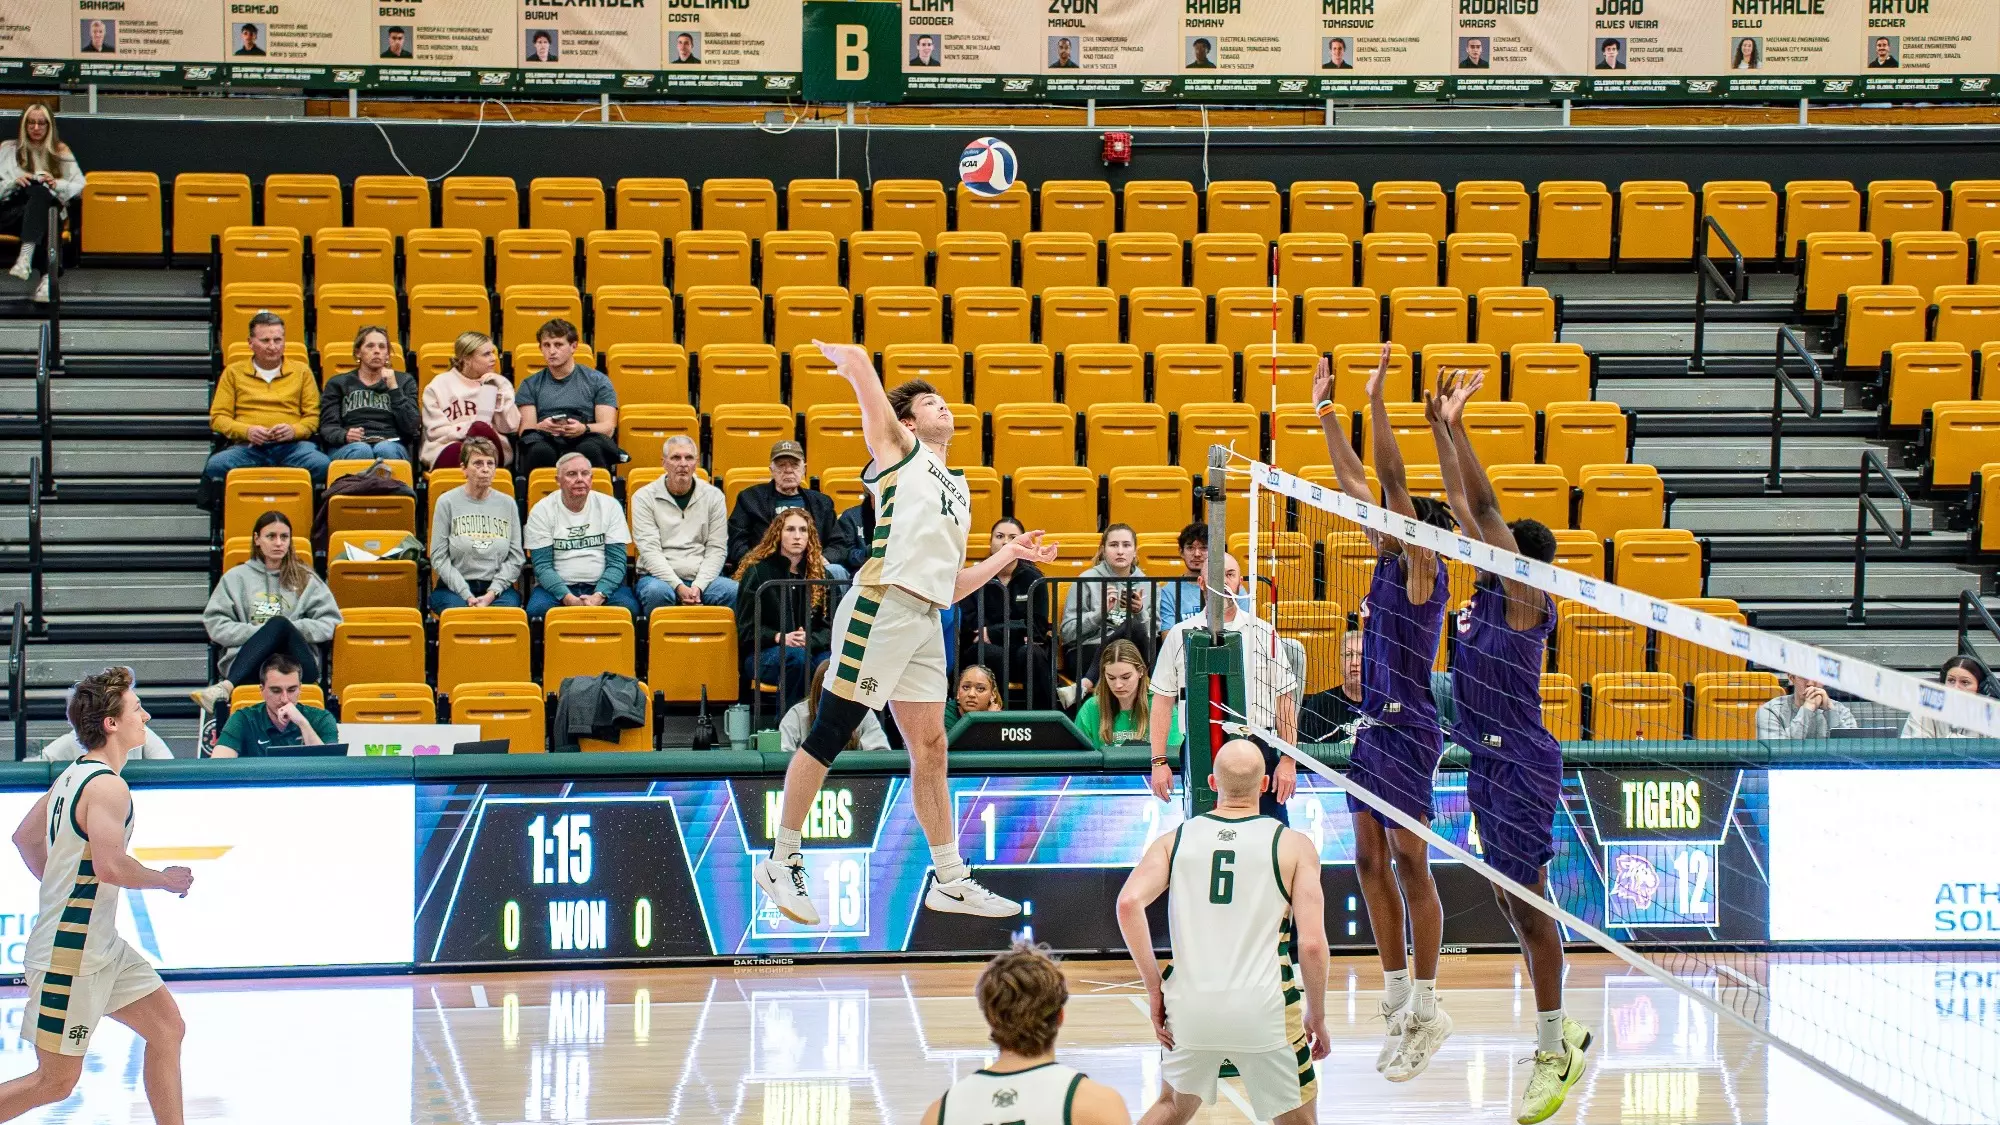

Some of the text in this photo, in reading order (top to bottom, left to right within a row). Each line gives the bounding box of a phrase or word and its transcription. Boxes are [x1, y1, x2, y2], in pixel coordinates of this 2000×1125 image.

[231, 4, 279, 14] BERMEJO
[379, 7, 416, 17] BERNIS
[909, 0, 954, 11] LIAM
[1048, 0, 1098, 14] ZYON
[1322, 0, 1374, 14] MARK
[1459, 0, 1538, 14] RODRIGO
[1732, 0, 1824, 14] NATHALIE
[1869, 0, 1928, 14] ARTUR
[525, 11, 558, 20] BURUM
[668, 14, 700, 23] COSTA
[909, 16, 954, 25] GOODGER
[1048, 19, 1086, 28] MAKOUL
[1186, 19, 1224, 28] ROMANY
[1322, 19, 1374, 29] TOMASOVIC
[1459, 19, 1496, 28] VARGAS
[1596, 20, 1658, 29] ALVES VIEIRA
[1732, 19, 1762, 28] BELLO
[1868, 19, 1905, 28] BECHER
[836, 24, 870, 80] B
[452, 515, 508, 538] MISSOURI S&T
[554, 534, 604, 549] MEN'S VOLLEYBALL
[1001, 728, 1032, 741] POSS
[364, 744, 402, 757] WE
[1622, 780, 1700, 829] TIGERS
[981, 803, 995, 860] 1
[528, 814, 592, 884] 1:15
[1209, 850, 1235, 904] 6
[1674, 850, 1708, 914] 12
[824, 860, 862, 927] 13
[504, 898, 651, 950] 0 WON 0
